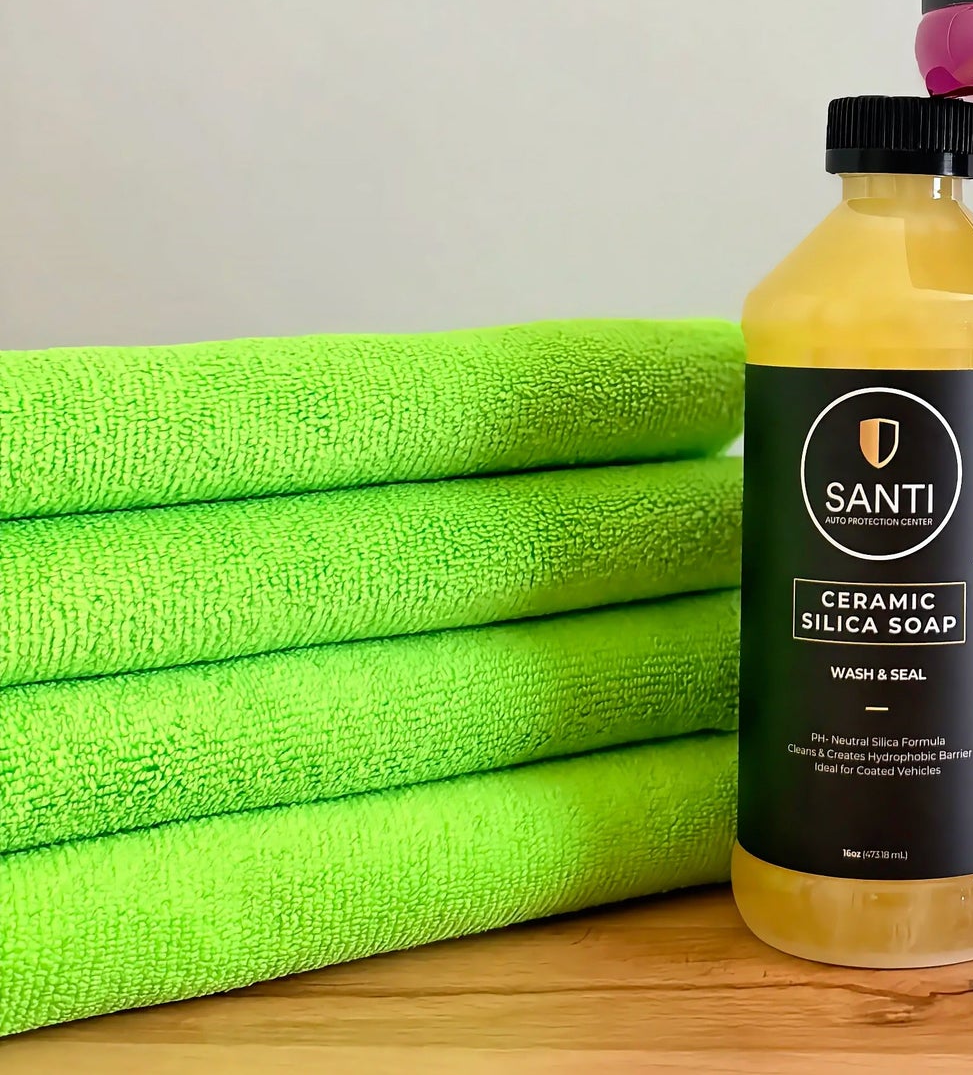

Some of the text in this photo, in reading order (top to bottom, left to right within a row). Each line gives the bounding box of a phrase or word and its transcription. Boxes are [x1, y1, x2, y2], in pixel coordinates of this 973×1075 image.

[826, 482, 933, 513] SANTI
[848, 517, 899, 525] PROTECTION
[822, 591, 934, 609] CERAMIC
[802, 613, 956, 634] SILICA SOAP
[831, 666, 926, 680] WASH & SEAL
[812, 733, 945, 747] PH- Neutral Silica Formula
[788, 744, 972, 763] Cleans & Creates Hydrophobic Barrier
[815, 763, 941, 775] Ideal for Coated Vehicles
[843, 849, 907, 860] 16oz (47318 mL)
